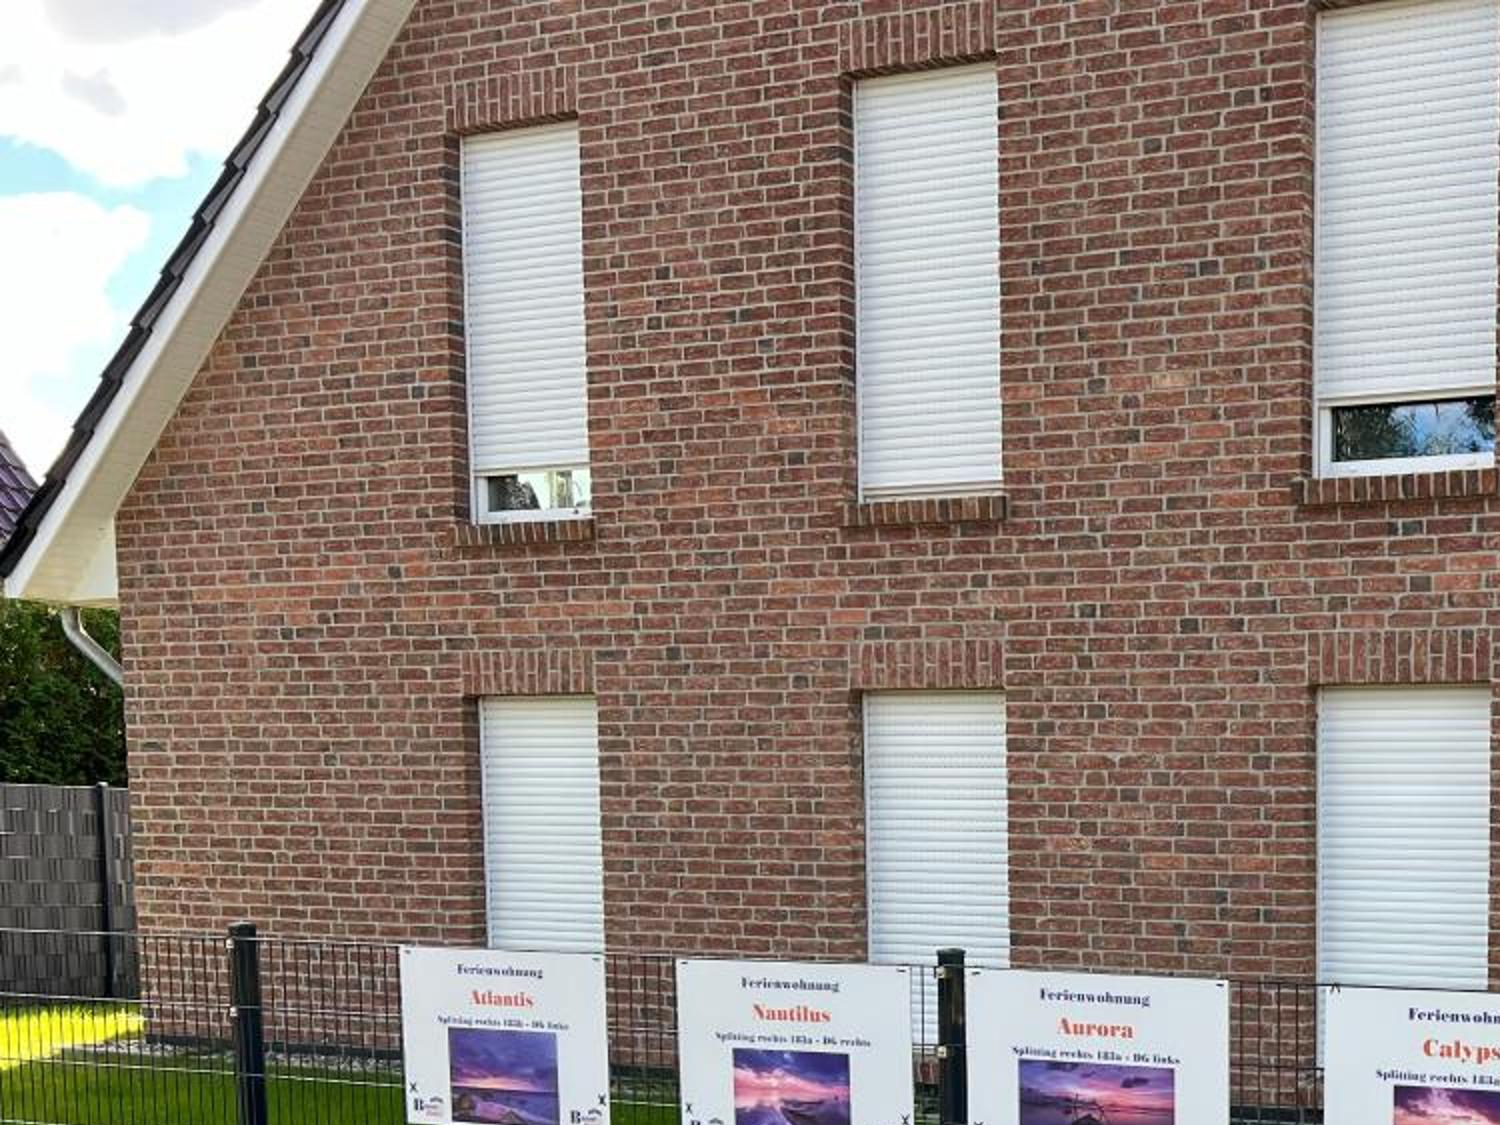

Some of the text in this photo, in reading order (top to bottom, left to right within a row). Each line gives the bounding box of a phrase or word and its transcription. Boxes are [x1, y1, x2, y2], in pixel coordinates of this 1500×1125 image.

[457, 963, 543, 979] Ferienwohnung
[741, 976, 840, 993] Ferienwohnung
[471, 989, 535, 1009] Atlantis
[1040, 987, 1150, 1008] Ferienwohnung
[753, 1003, 832, 1023] Nautilus
[1057, 1017, 1135, 1039] Aurora
[1376, 1069, 1427, 1082] Splitting
